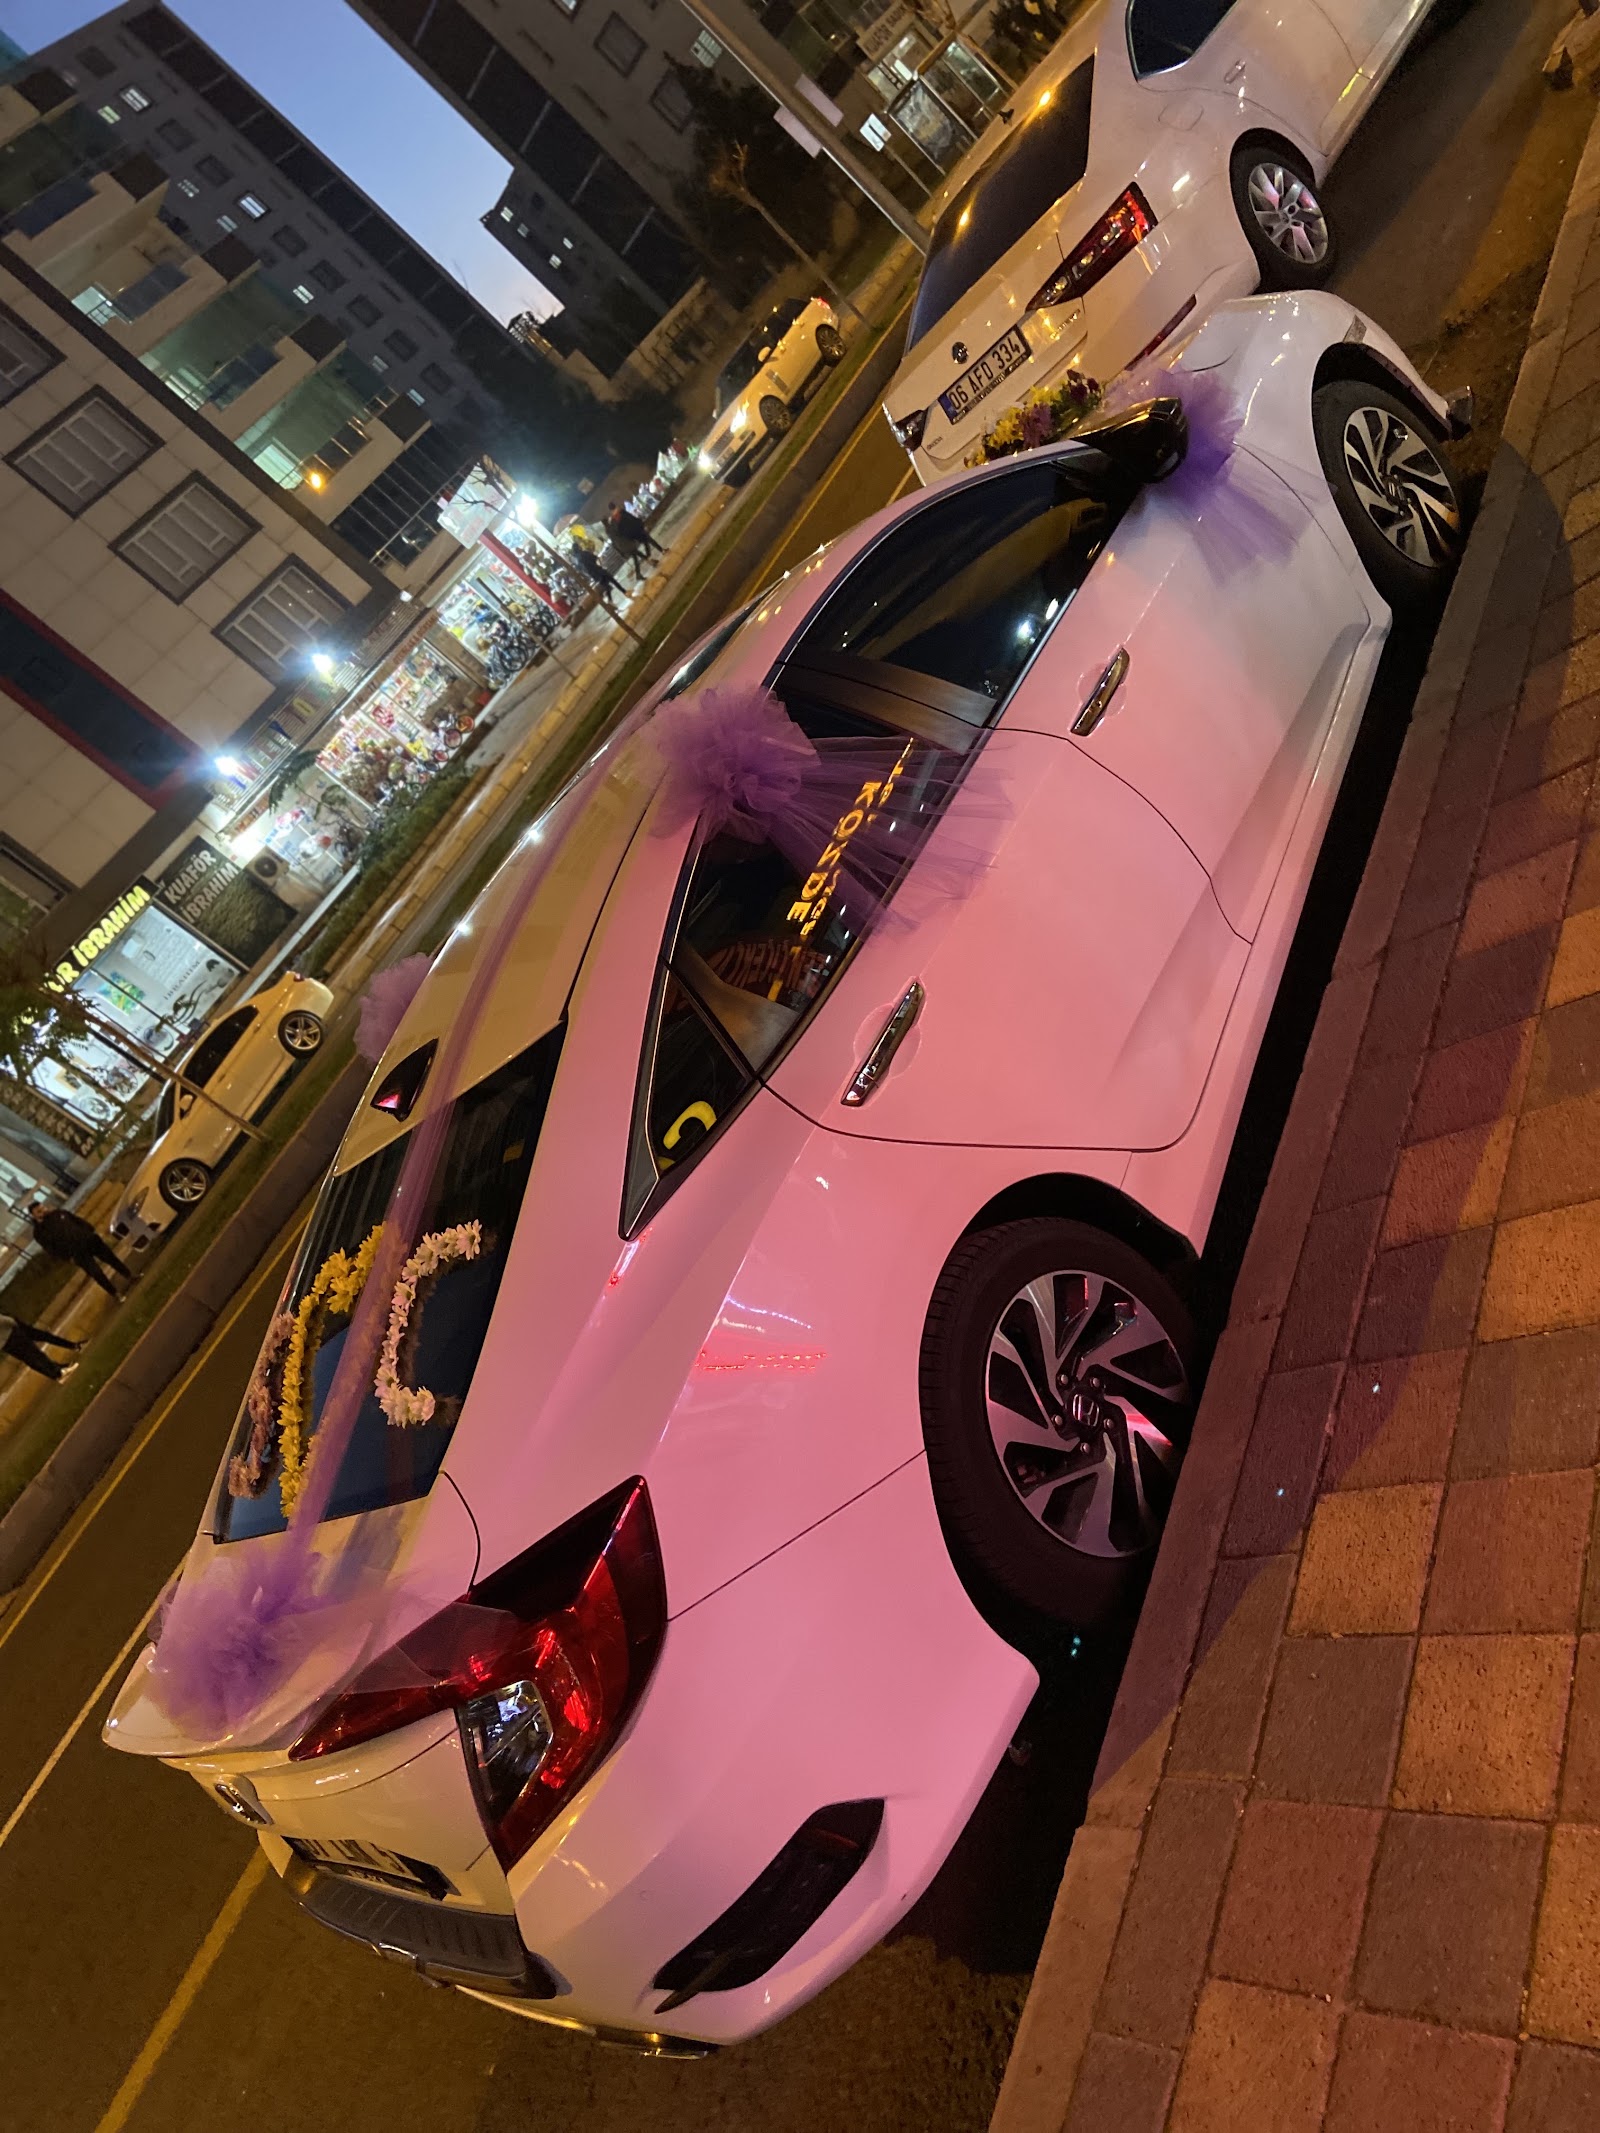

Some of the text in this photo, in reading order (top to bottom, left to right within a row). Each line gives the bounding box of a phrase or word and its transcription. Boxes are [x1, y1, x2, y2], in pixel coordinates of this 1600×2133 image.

[949, 384, 969, 411] 06
[968, 361, 994, 395] AFD
[992, 336, 1021, 370] 334
[164, 849, 217, 905] KUAFÖR
[181, 862, 239, 924] İBRAHİM
[71, 885, 151, 967] İBRAHİM
